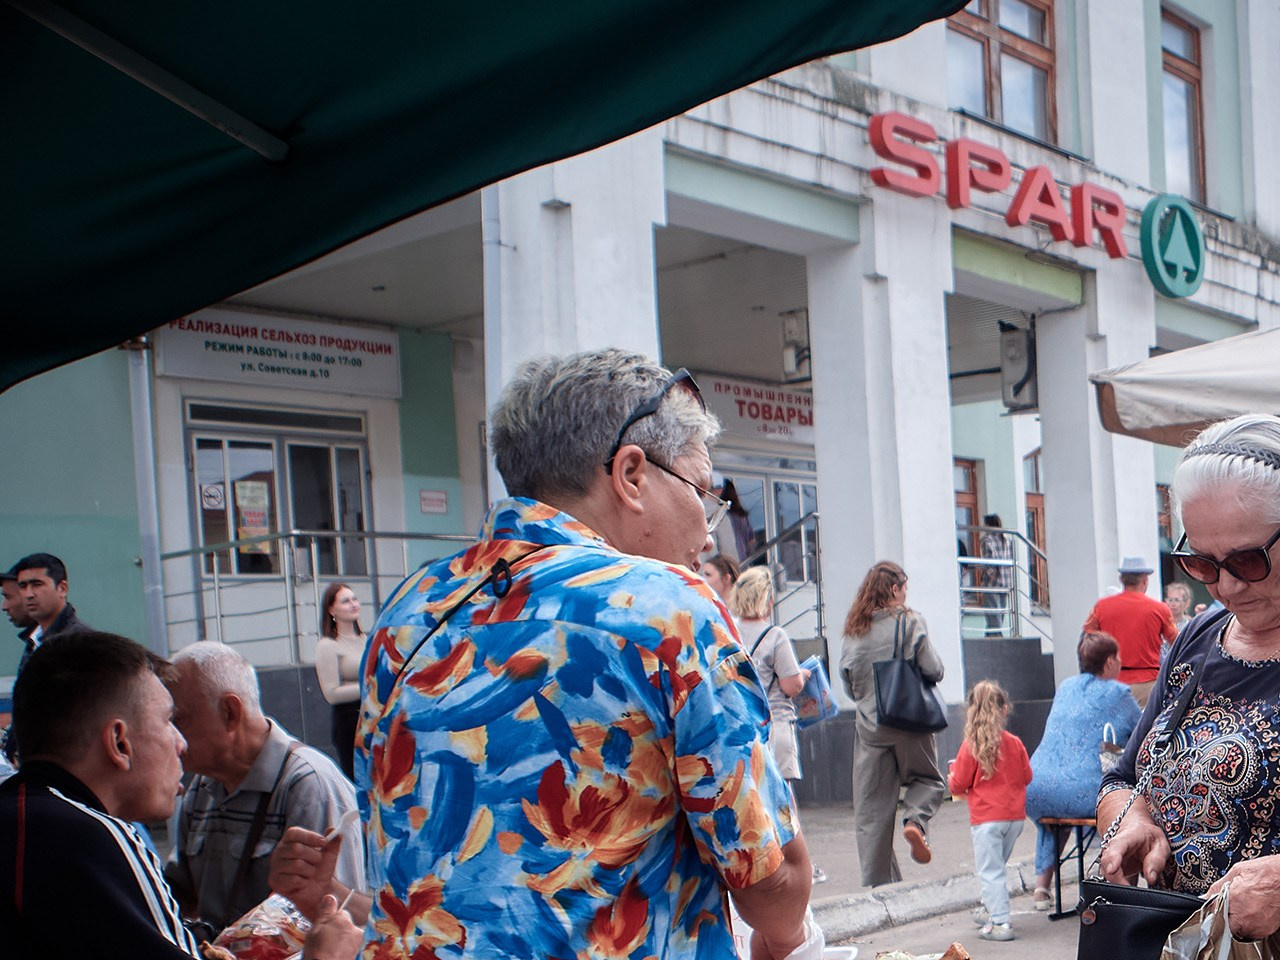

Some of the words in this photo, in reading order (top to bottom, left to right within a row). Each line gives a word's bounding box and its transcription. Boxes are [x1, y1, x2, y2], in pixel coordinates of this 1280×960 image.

[868, 111, 1128, 259] SPAR
[169, 319, 258, 340] РЕАЛИЗАЦИЯ
[261, 328, 317, 346] СЕЛЬХОЗ
[319, 335, 392, 356] ПРОДУКЦИИ
[204, 340, 244, 354] РЕЖИМ
[246, 345, 288, 359] РАБОТЫ
[324, 355, 335, 365] до
[338, 356, 362, 368] 17:00
[240, 362, 256, 372] ул.
[258, 362, 308, 377] Советская
[735, 399, 813, 426] ТОВАРЫ
[778, 426, 789, 435] 20
